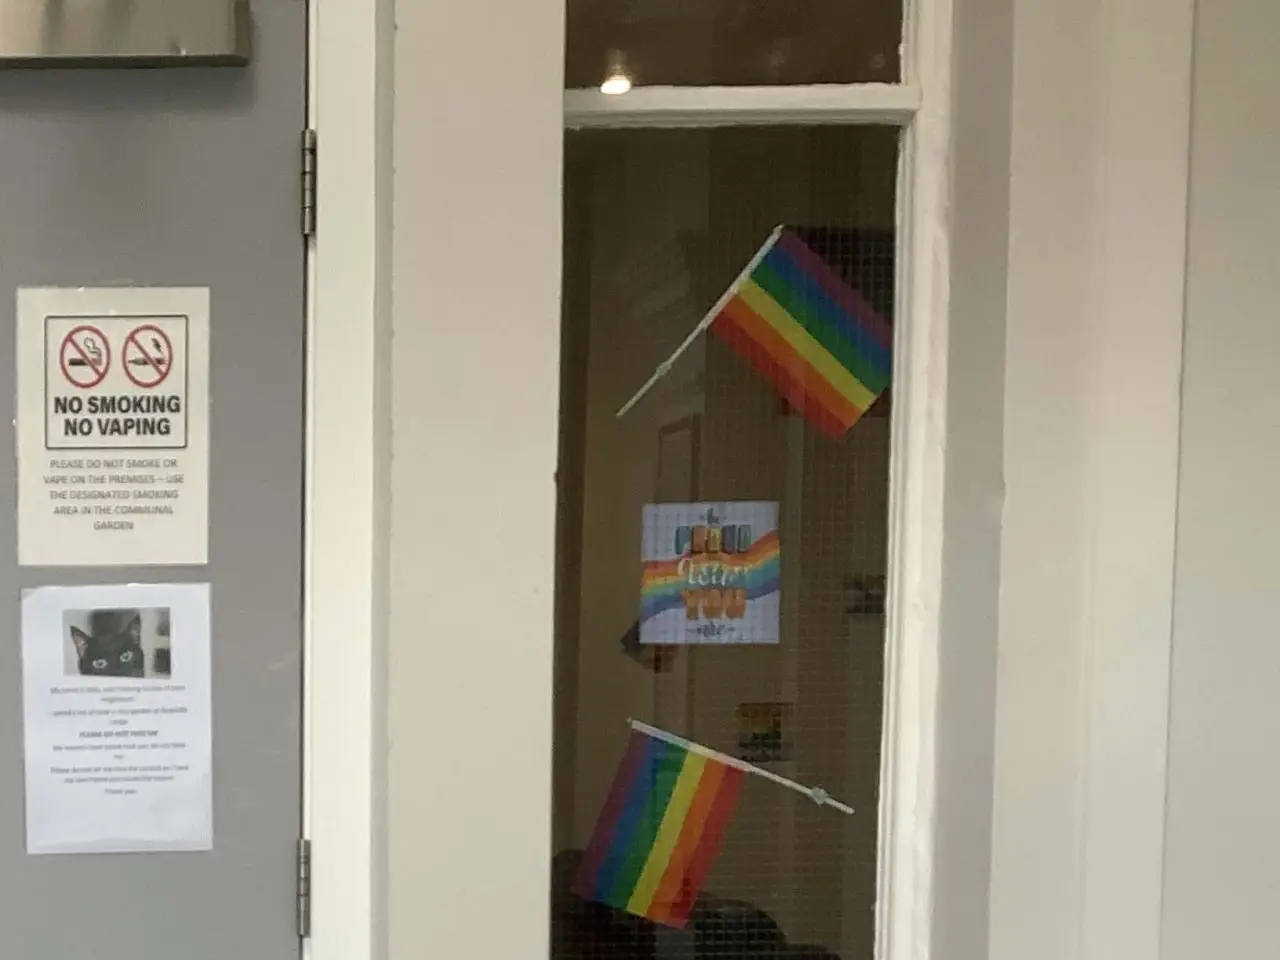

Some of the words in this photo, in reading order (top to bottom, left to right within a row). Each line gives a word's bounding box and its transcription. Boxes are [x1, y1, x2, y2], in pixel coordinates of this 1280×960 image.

[54, 396, 83, 415] NO
[87, 395, 181, 414] SMOKING
[64, 418, 93, 436] NO
[97, 418, 171, 436] VAPING
[50, 459, 84, 468] PLEASE
[86, 459, 102, 468] DO
[104, 459, 124, 468] NOT
[126, 459, 161, 468] SMOKE
[163, 459, 178, 468] OR
[43, 475, 68, 484] VAPE
[70, 475, 86, 484] ON
[88, 475, 106, 484] THE
[109, 475, 155, 484] PREMISES
[166, 475, 185, 484] USE
[49, 490, 68, 499] THE
[70, 490, 130, 499] DESIGNATED
[132, 490, 179, 499] SMOKING
[53, 506, 78, 515] AREA
[81, 506, 92, 514] IN
[95, 506, 112, 514] THE
[114, 505, 174, 514] COMMUNAL
[93, 521, 134, 530] GARDEN
[681, 587, 746, 620] YOU
